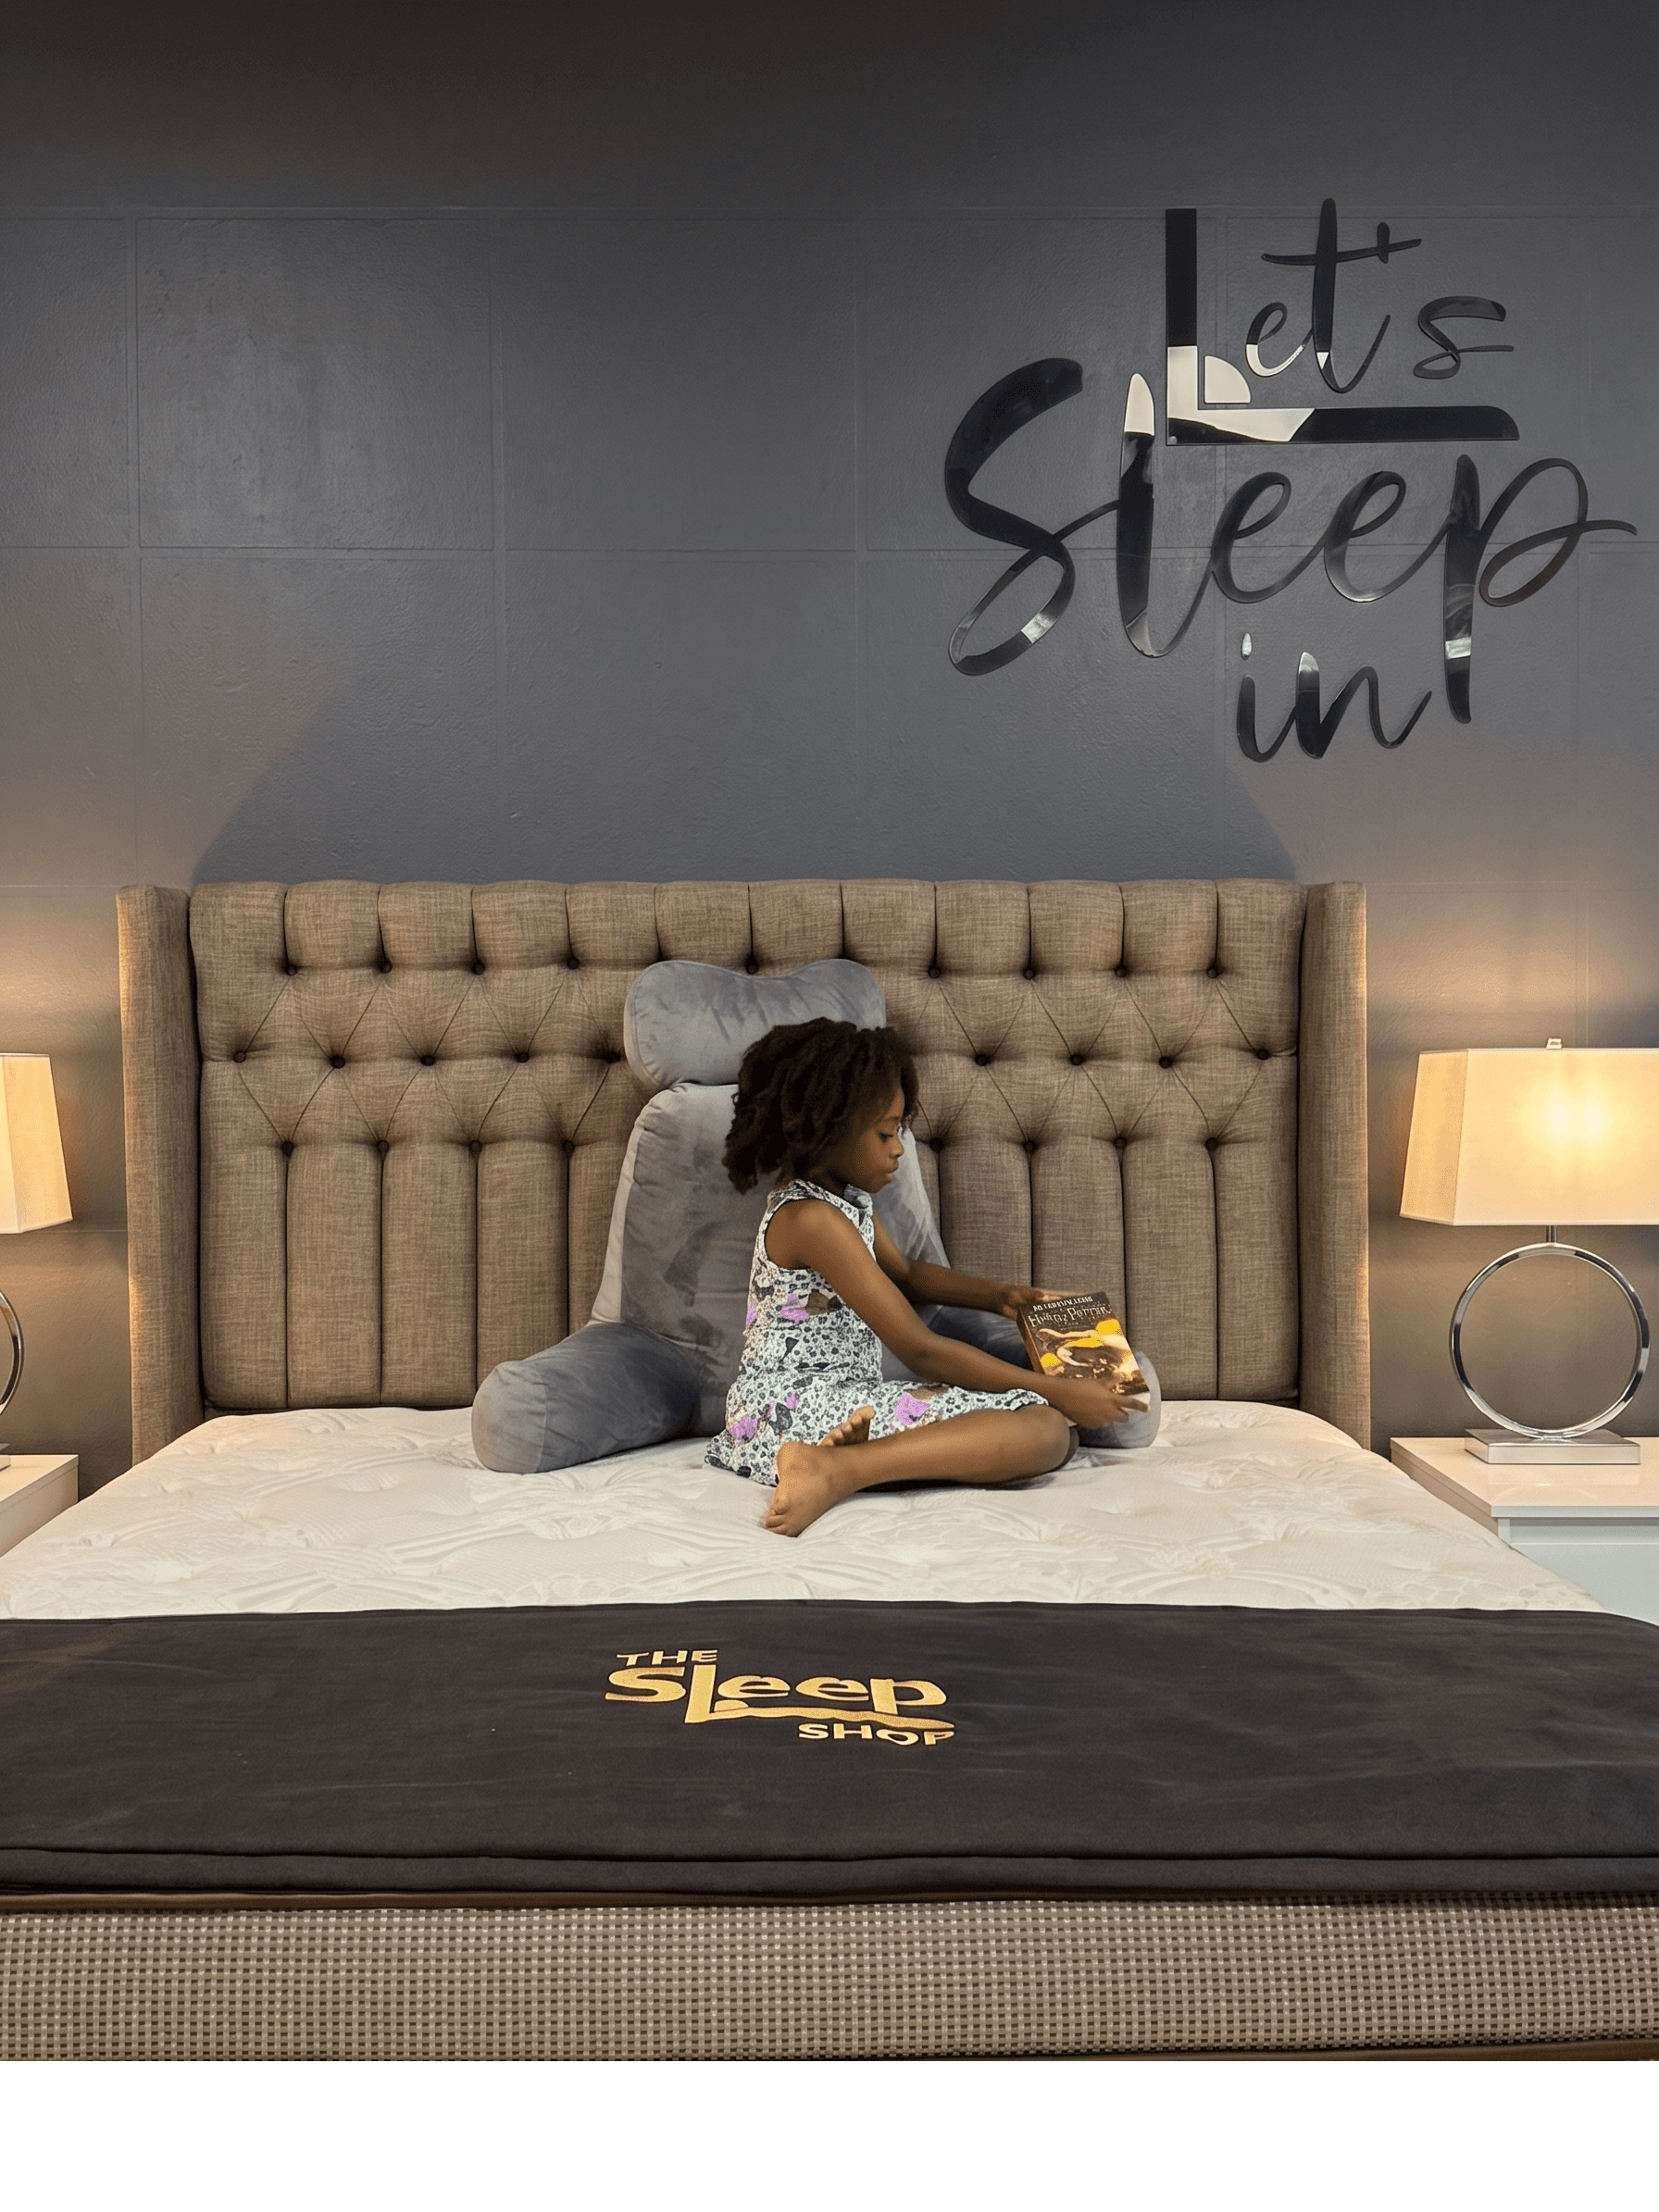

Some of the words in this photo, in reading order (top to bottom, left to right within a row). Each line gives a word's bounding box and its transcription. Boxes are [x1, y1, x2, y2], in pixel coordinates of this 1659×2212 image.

[1166, 198, 1519, 445] Let's
[944, 357, 1638, 724] Sleep
[1236, 632, 1432, 763] in
[617, 1649, 717, 1666] THE
[798, 1722, 954, 1746] SHOP
